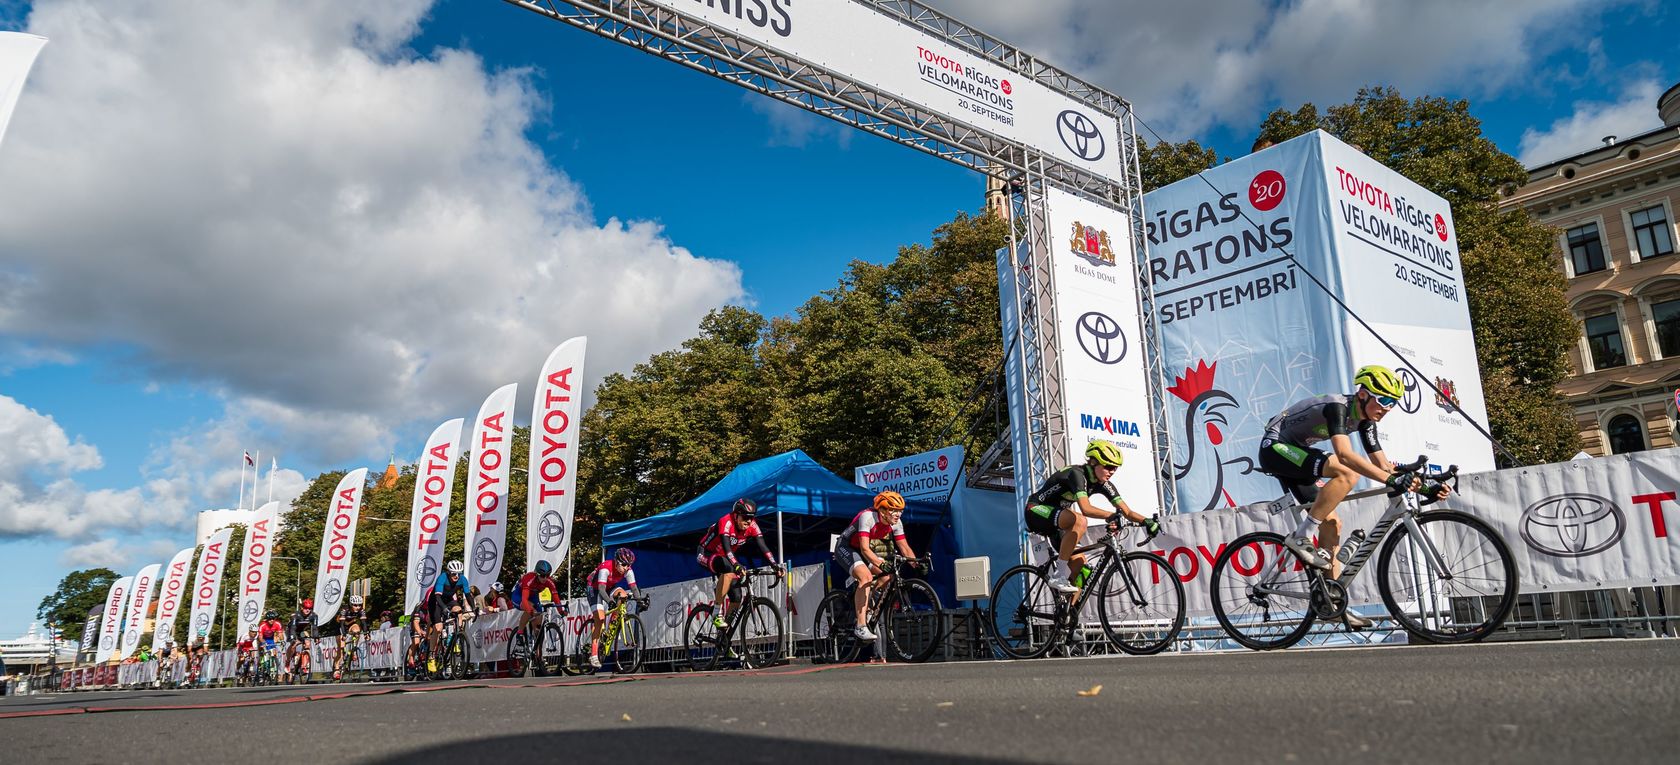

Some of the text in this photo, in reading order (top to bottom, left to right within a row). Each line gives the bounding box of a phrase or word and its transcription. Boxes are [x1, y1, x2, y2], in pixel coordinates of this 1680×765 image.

[917, 46, 963, 75] TOYOTA
[965, 67, 999, 90] RĪGAS
[918, 62, 1013, 110] VELOMARATONS
[1336, 166, 1393, 216] TOYOTA
[1394, 196, 1434, 235] RĪGAS
[1340, 199, 1453, 271] VELOMARATONS
[1160, 264, 1296, 324] SEPTEMBRĪ
[540, 367, 573, 505] TOYOTA
[1081, 413, 1141, 437] MAXIMA
[418, 442, 451, 550] TOYOTA
[476, 411, 505, 531] TOYOTA
[863, 467, 901, 484] TOYOTA
[904, 461, 935, 477] RĪGAS
[327, 487, 356, 574] TOYOTA
[1273, 503, 1283, 512] 23
[197, 542, 223, 610] TOYOTA
[245, 519, 269, 596] TOYOTA
[1034, 545, 1041, 553] 49
[1343, 520, 1393, 577] CANYON
[106, 587, 123, 633] HYBRID
[131, 576, 149, 627] HYBRID
[161, 561, 186, 620] TOYOTA
